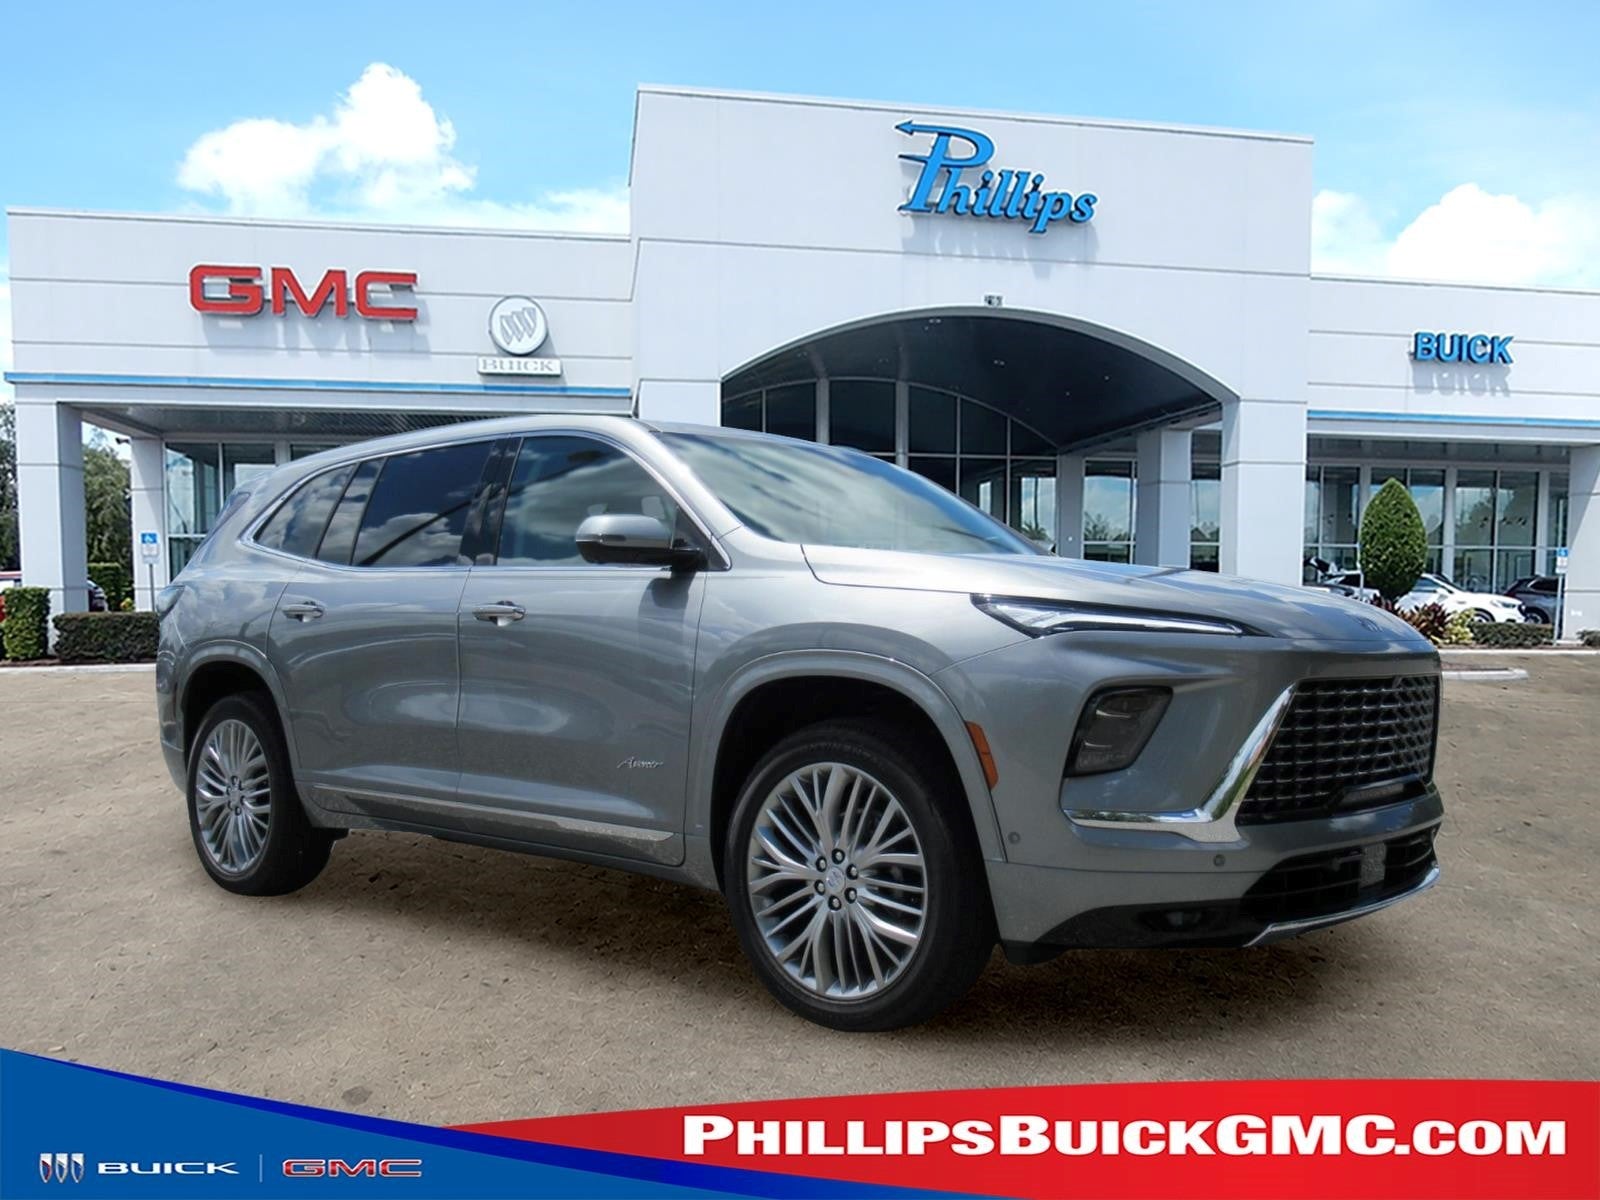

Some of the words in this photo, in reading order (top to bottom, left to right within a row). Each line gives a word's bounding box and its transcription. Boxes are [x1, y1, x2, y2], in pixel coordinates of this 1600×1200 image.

[894, 120, 1098, 234] Phillips
[189, 264, 418, 321] GMC
[482, 359, 554, 372] BUICK
[1414, 332, 1514, 364] BUICK
